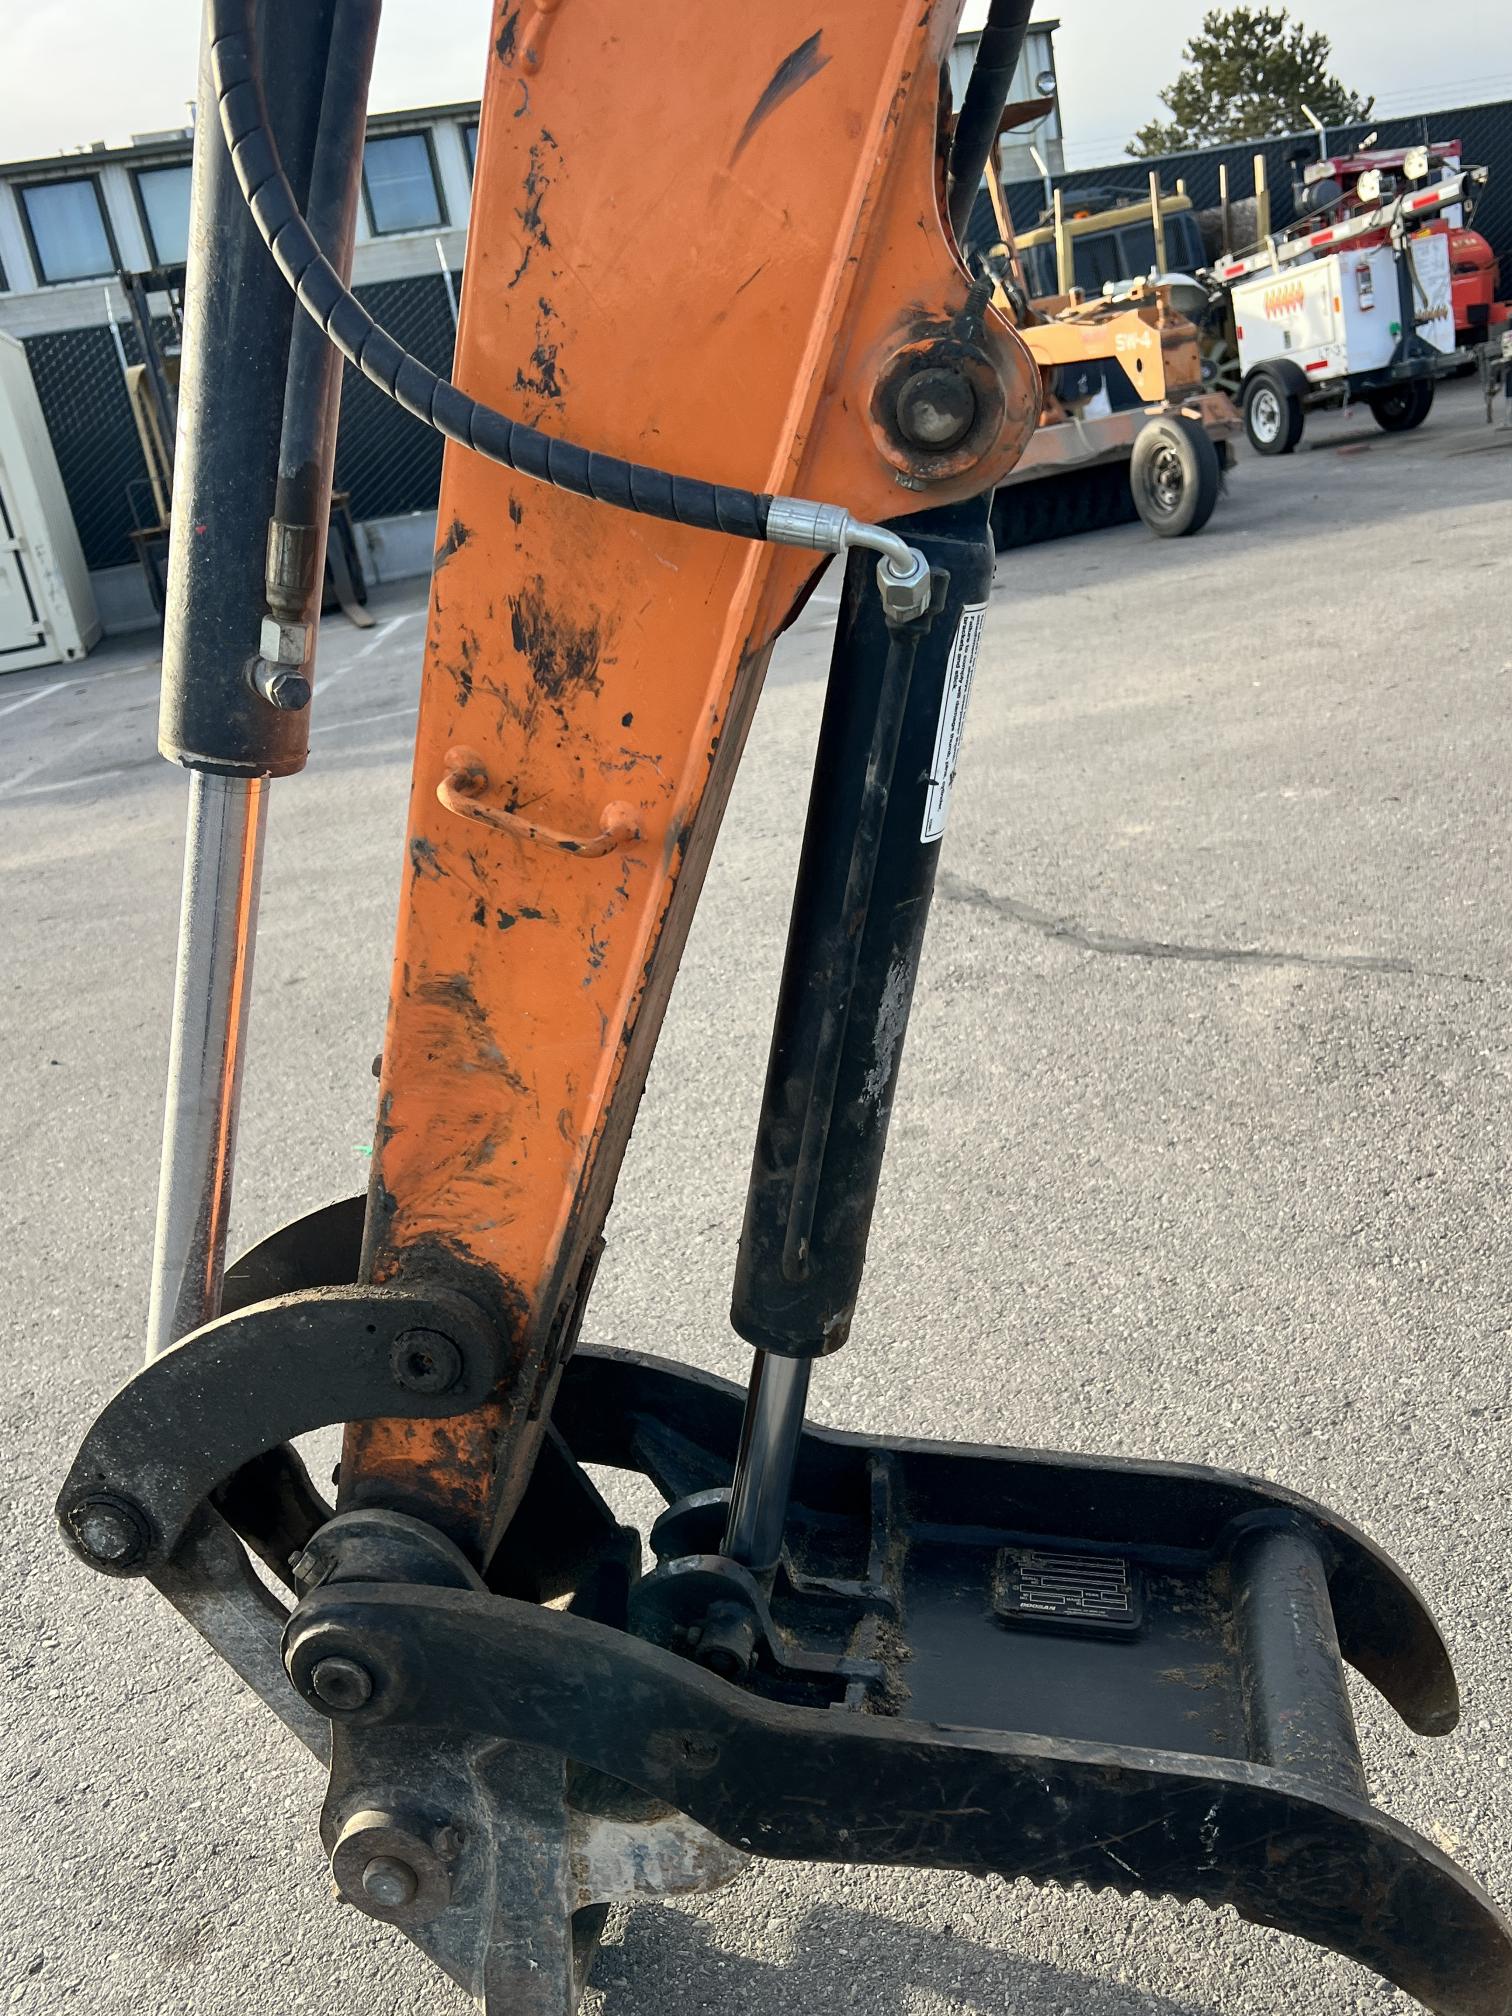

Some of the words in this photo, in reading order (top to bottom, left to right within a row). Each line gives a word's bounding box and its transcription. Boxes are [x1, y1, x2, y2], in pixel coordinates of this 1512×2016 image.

[1116, 331, 1151, 352] SW-4
[958, 616, 968, 651] brackets
[966, 615, 974, 642] Failure
[1020, 1602, 1056, 1611] DOOSAN
